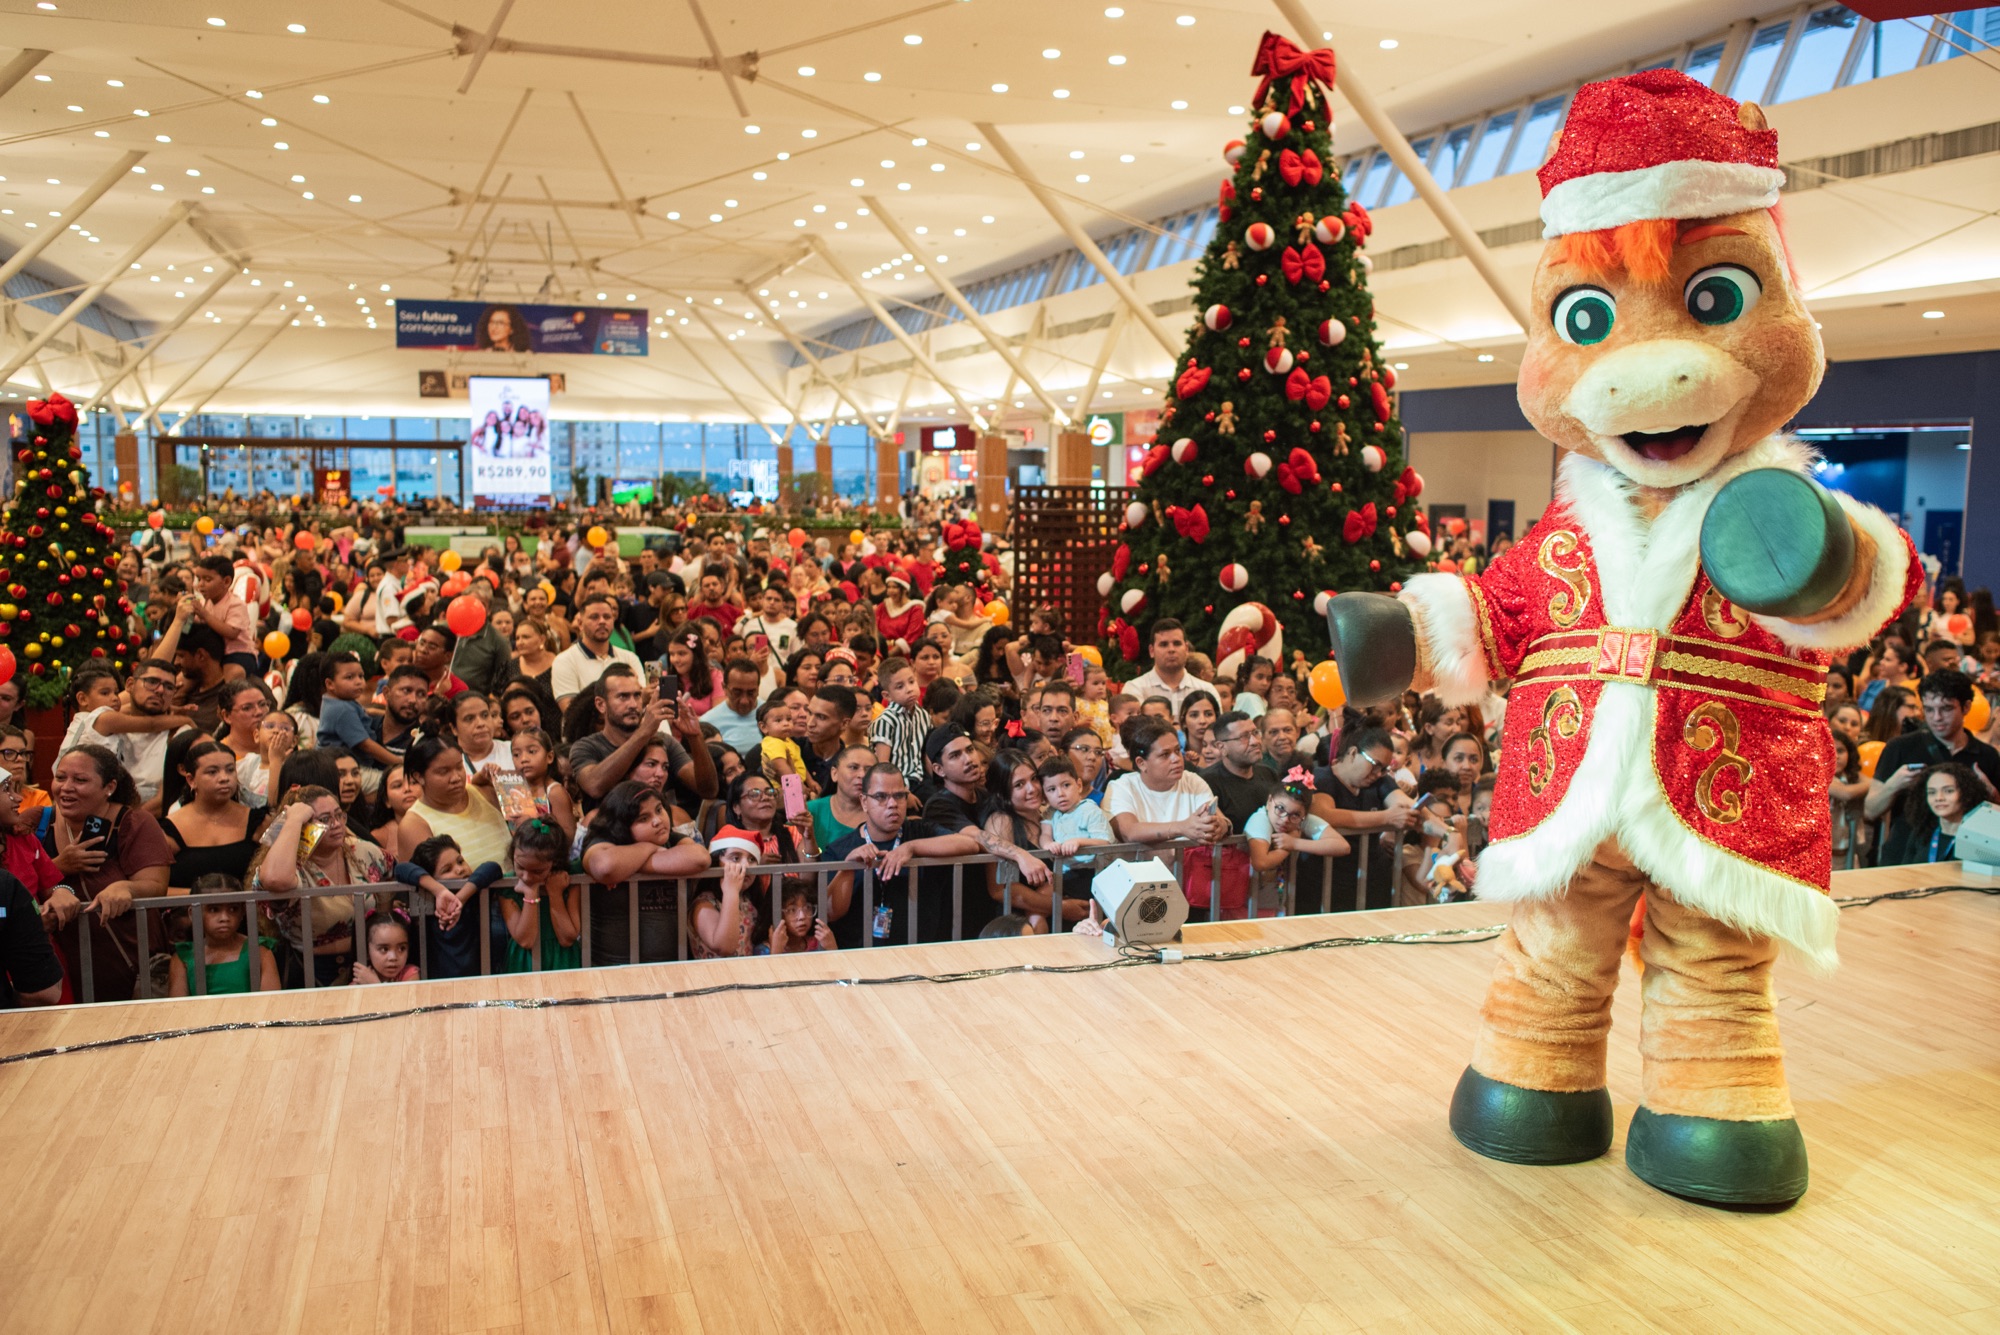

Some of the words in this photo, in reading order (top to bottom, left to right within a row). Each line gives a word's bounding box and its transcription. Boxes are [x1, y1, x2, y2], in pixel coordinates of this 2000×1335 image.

[399, 310, 421, 322] Seu
[422, 310, 458, 323] futuro
[399, 323, 445, 336] começa
[447, 323, 473, 337] aqui
[478, 465, 547, 480] R$289,90
[729, 459, 779, 478] FOME
